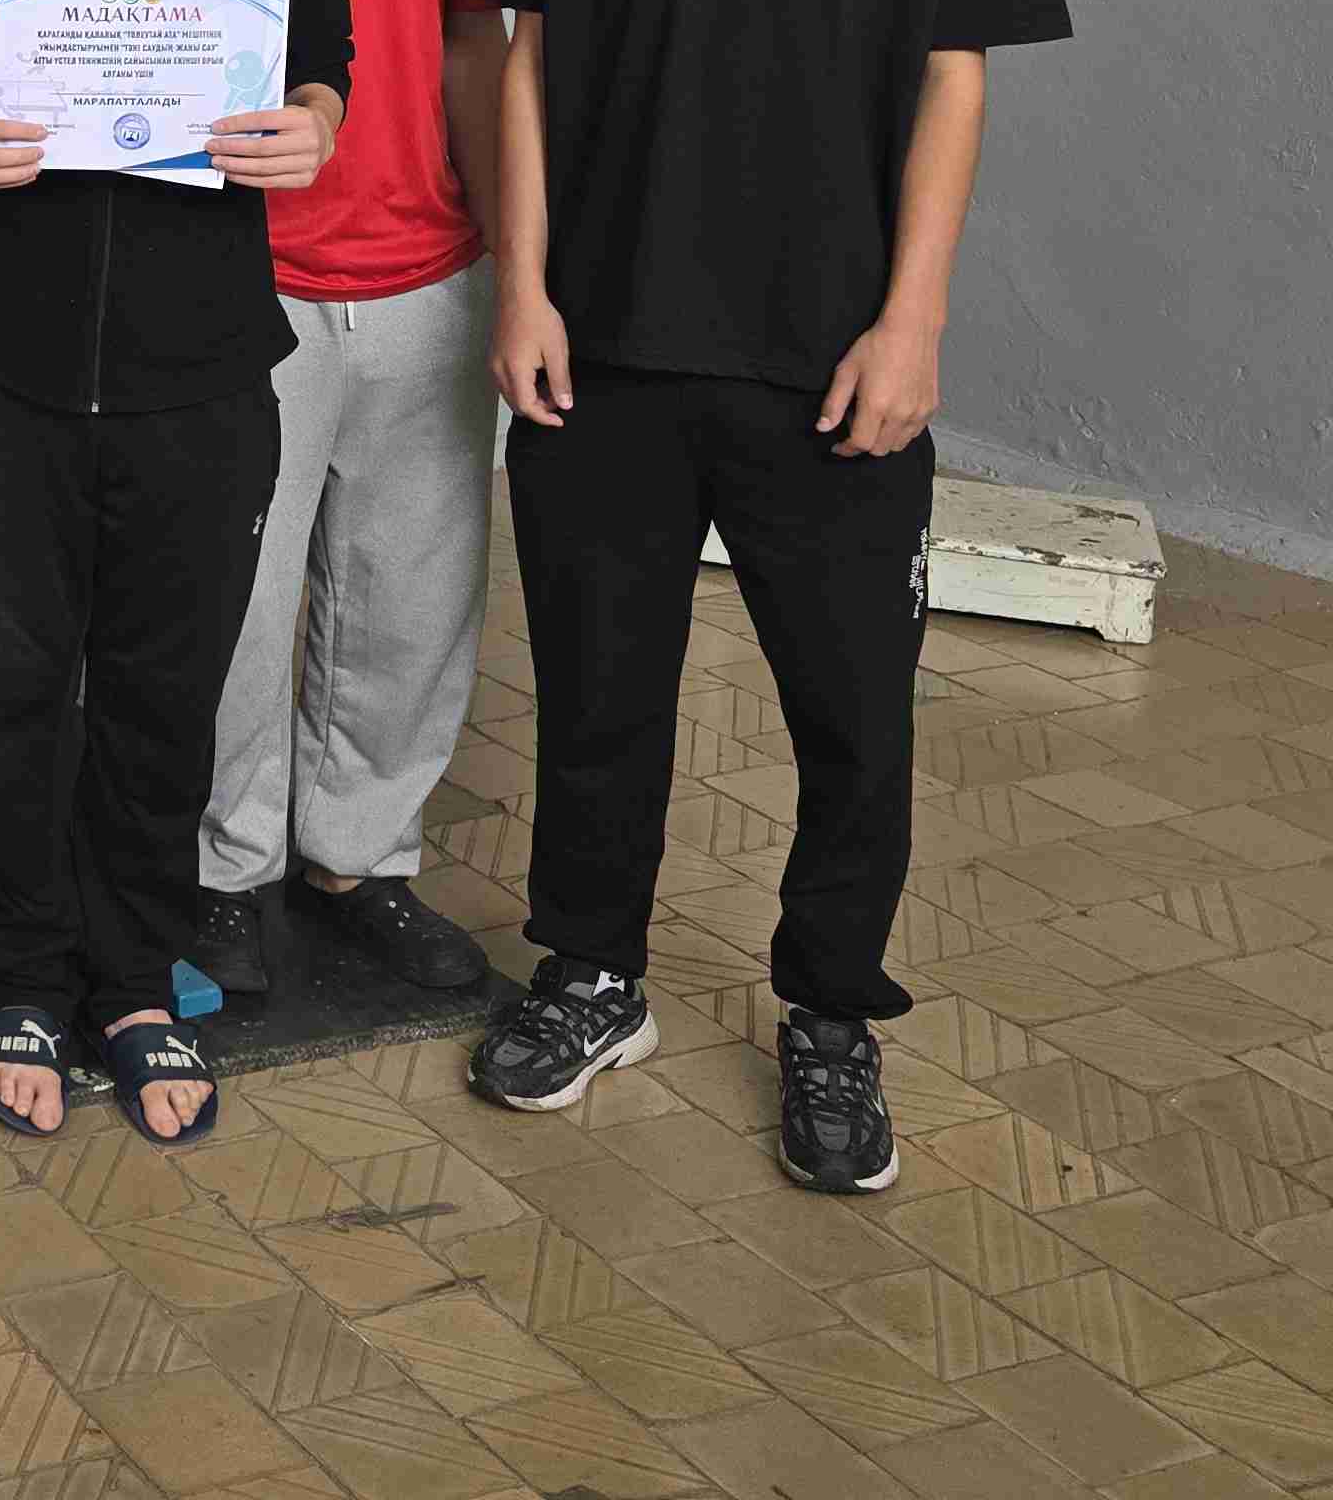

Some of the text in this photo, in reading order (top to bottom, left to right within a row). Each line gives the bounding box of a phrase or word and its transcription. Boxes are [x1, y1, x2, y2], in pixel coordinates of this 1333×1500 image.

[62, 6, 203, 23] МАДАҚТАМА
[73, 98, 181, 107] МАРАПАТТАЛАДЫ
[145, 1051, 193, 1068] PUMA
